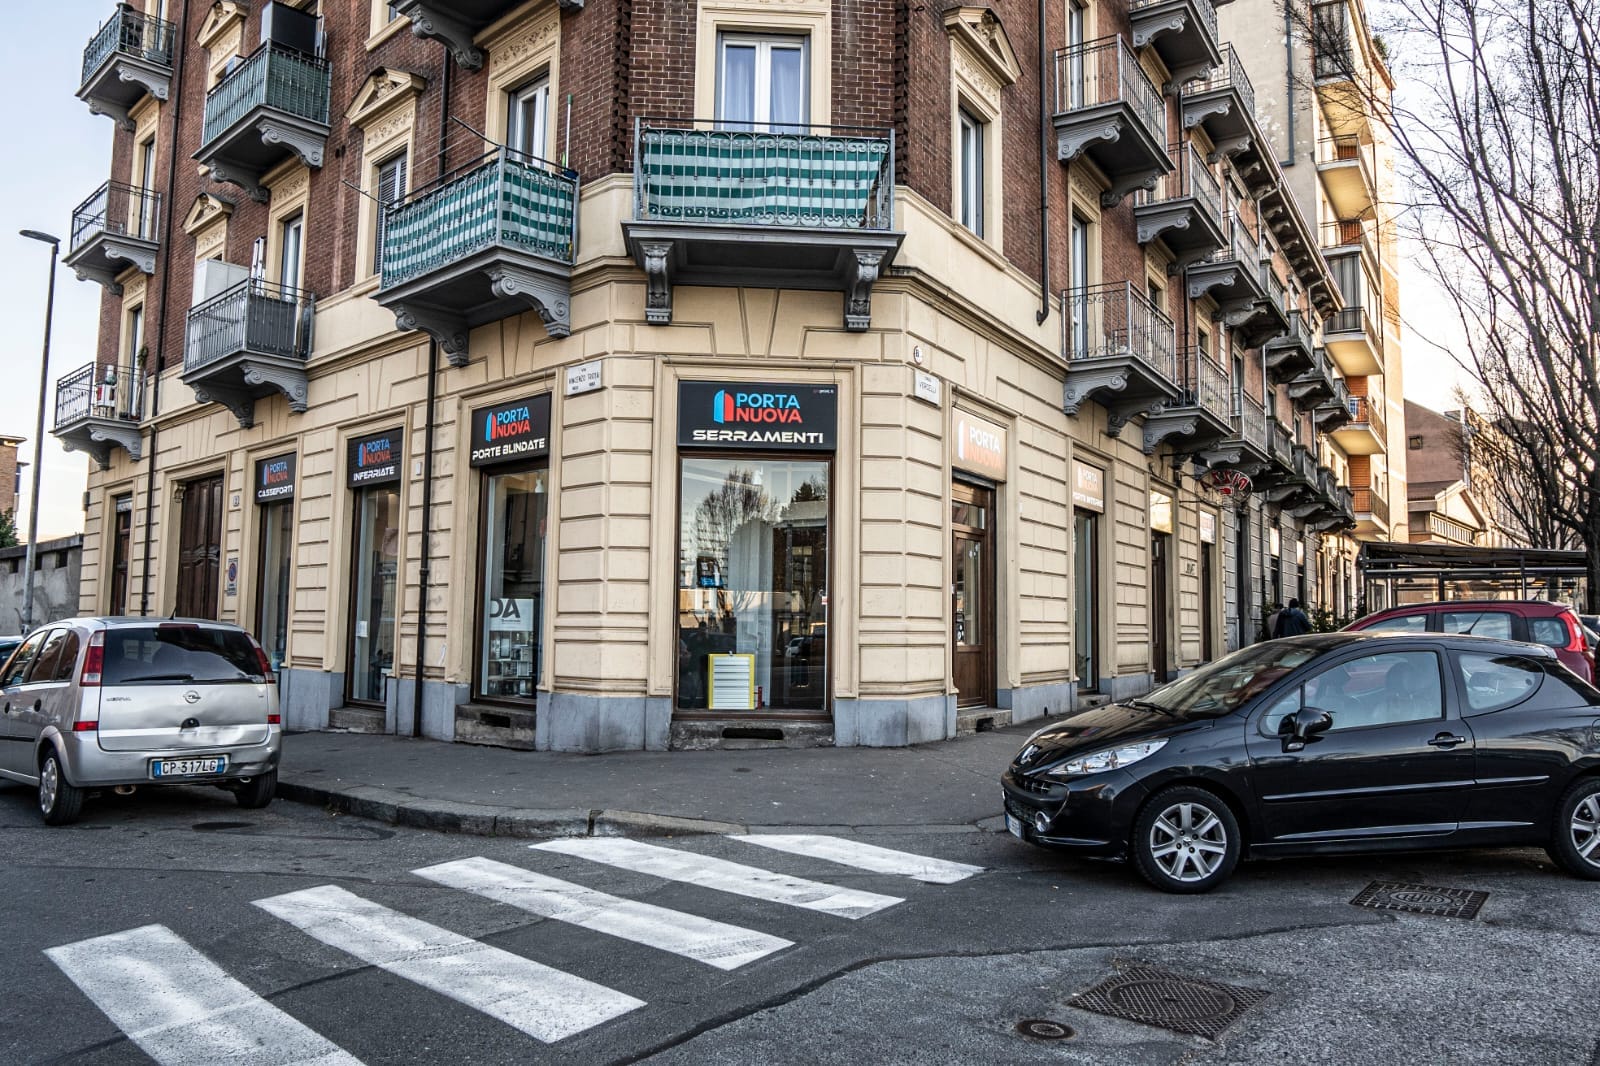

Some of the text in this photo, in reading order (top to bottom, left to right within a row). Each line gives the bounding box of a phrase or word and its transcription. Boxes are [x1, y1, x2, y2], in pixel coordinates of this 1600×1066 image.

[736, 393, 801, 409] PORTA
[497, 406, 530, 425] PORTA
[736, 408, 803, 423] NUOVA
[496, 419, 531, 438] NUOVA
[692, 429, 824, 444] SERRAMENTI
[969, 425, 1001, 454] PORTA
[366, 439, 390, 453] PORTA
[472, 437, 546, 461] PORTE BLINDATE
[366, 449, 391, 464] NUOVA
[269, 461, 288, 474] PORTA
[353, 465, 395, 481] INFERRIATE
[257, 484, 294, 498] CASSEFORTI
